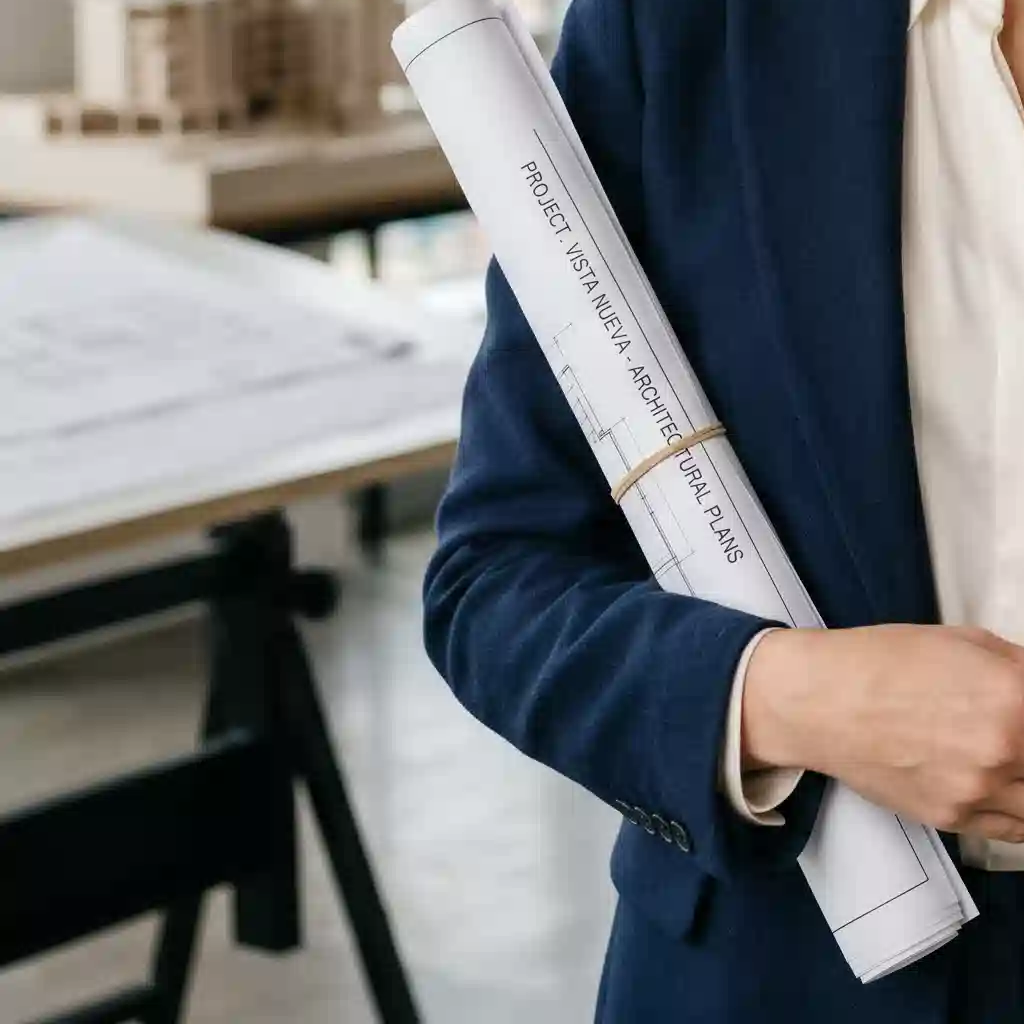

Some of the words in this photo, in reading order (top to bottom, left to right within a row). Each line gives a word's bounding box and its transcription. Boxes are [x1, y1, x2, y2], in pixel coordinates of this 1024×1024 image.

[566, 242, 599, 294] VISTA
[591, 293, 631, 355] NUEVA
[628, 365, 711, 505] ARCHITECTURAL
[703, 505, 744, 564] PLANS
